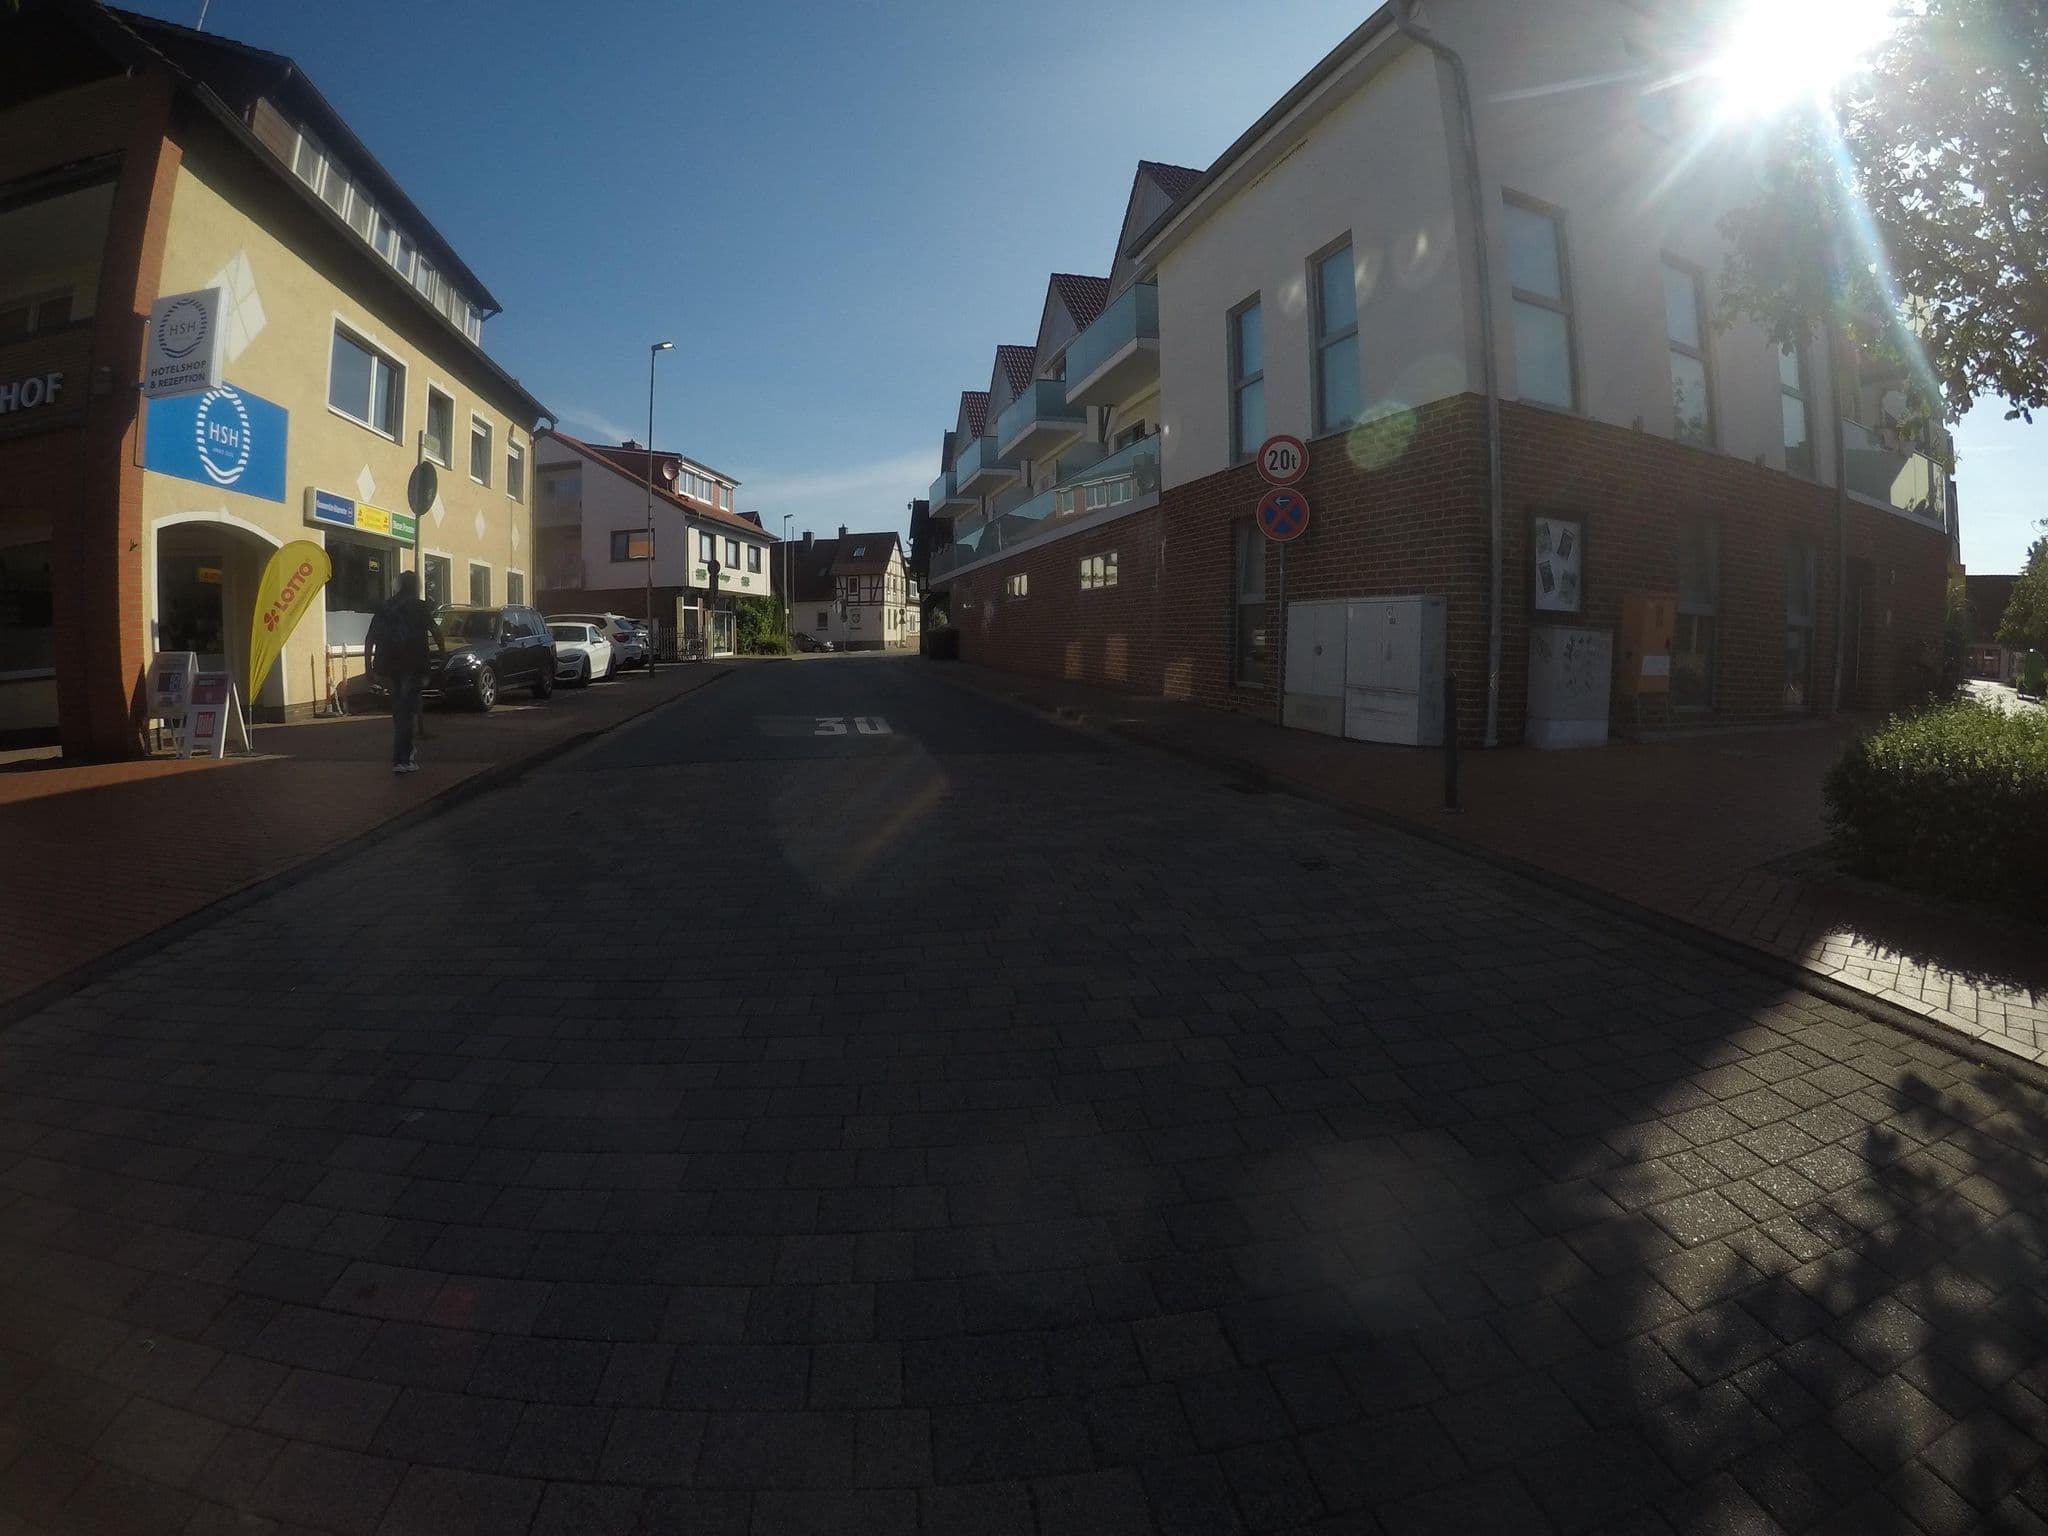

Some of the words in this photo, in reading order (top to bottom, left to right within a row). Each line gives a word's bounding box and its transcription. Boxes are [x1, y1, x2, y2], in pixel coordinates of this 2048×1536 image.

[169, 321, 196, 336] HSH
[150, 380, 156, 389] &
[158, 373, 206, 387] REZEPTION
[0, 372, 64, 414] HOF
[209, 421, 239, 448] HSH
[273, 562, 313, 612] LOTTO
[814, 717, 894, 735] 30
